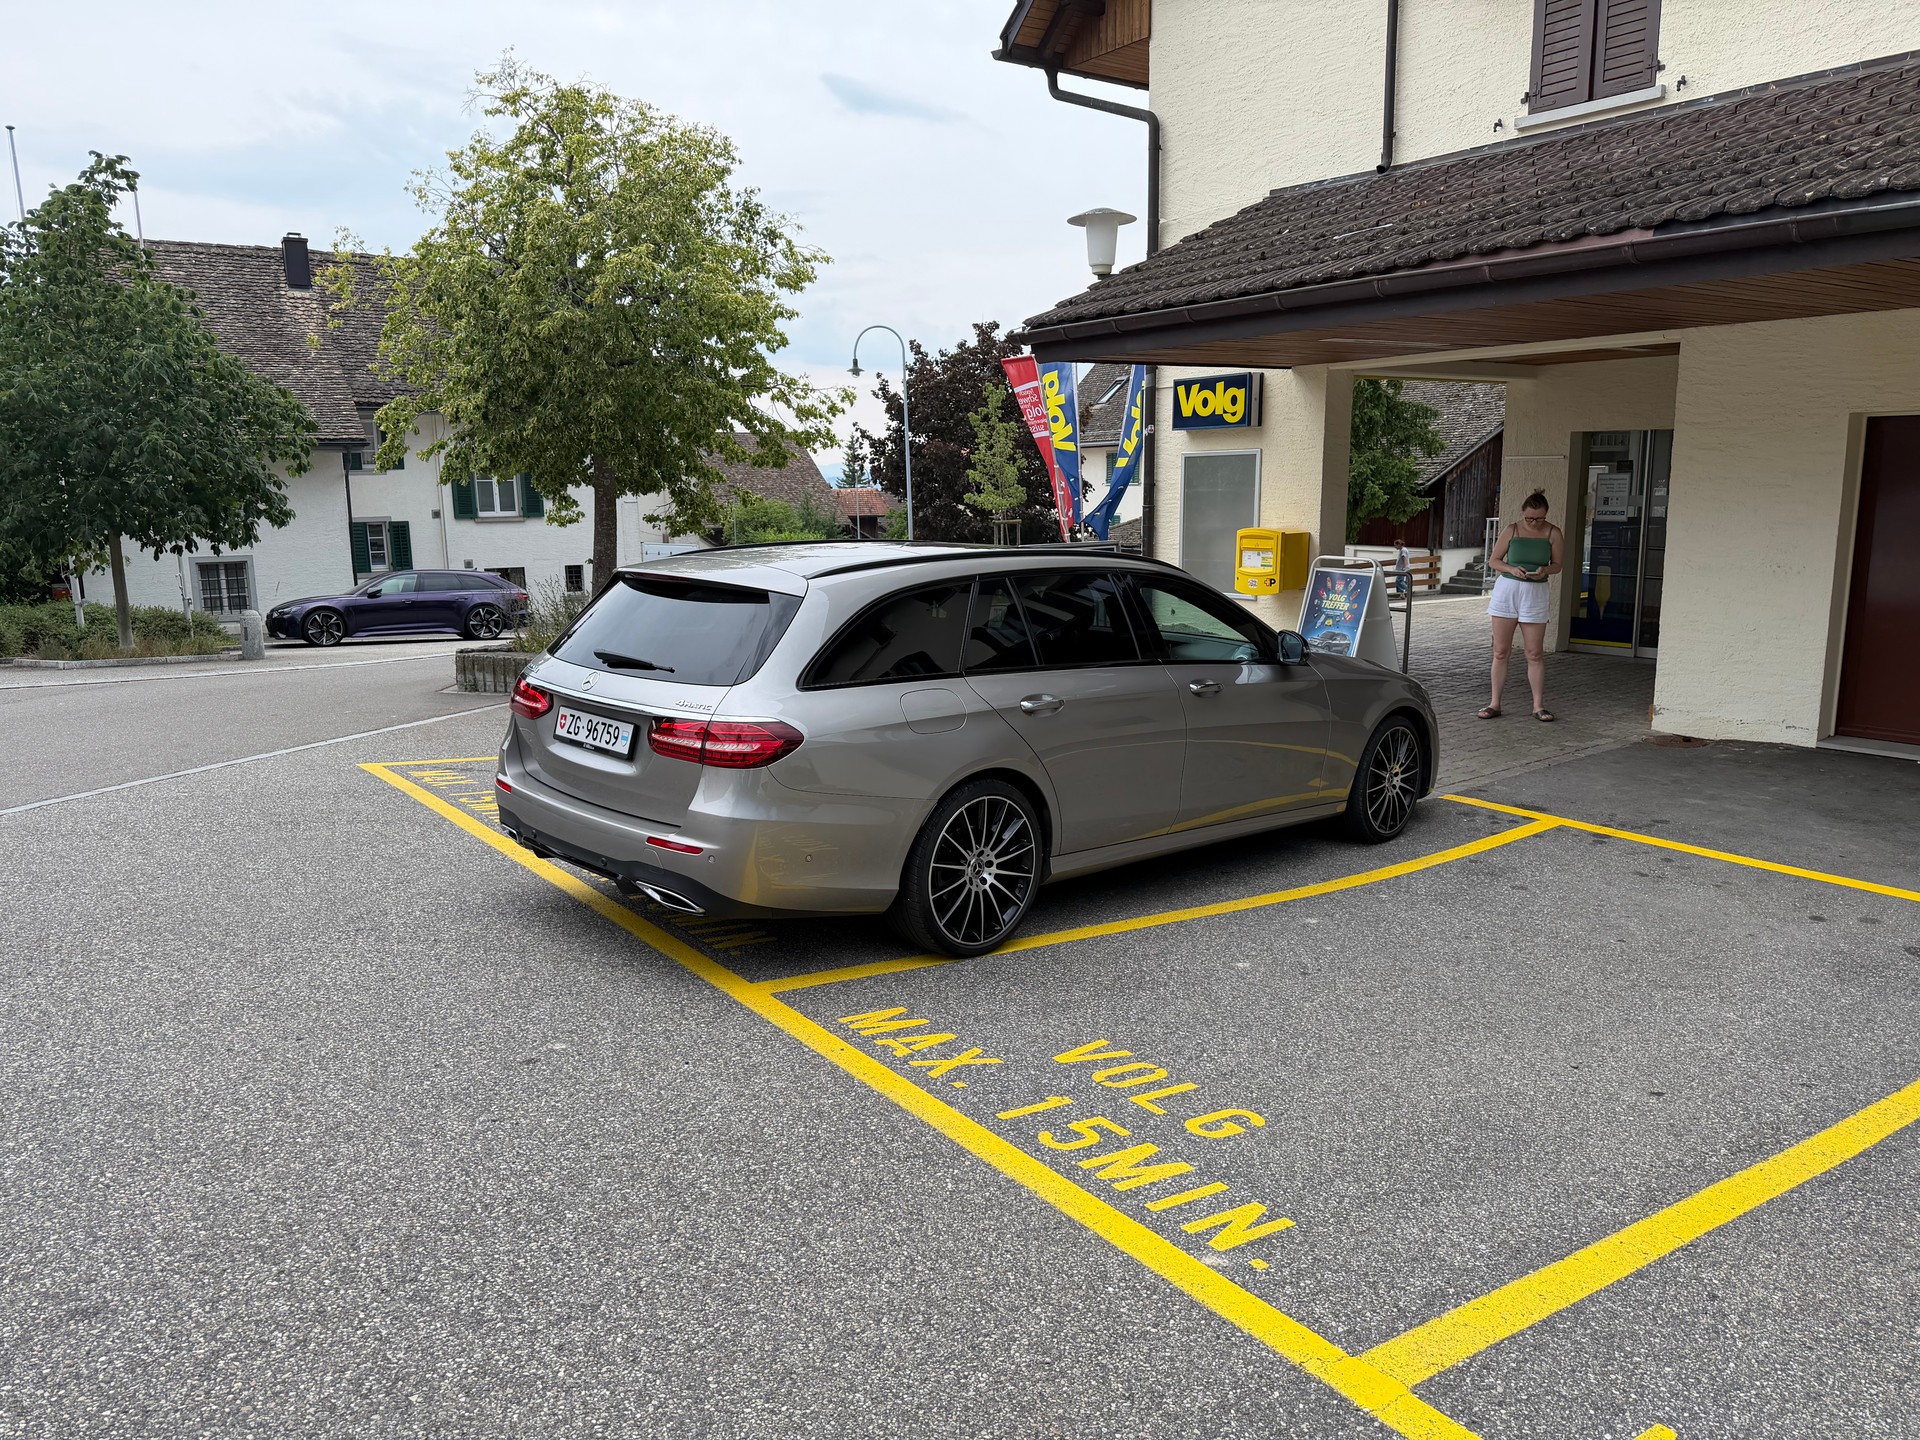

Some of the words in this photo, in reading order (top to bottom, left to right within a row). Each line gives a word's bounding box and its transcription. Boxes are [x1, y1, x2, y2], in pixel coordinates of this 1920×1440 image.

[1177, 381, 1246, 424] Volg
[1321, 600, 1350, 610] TREFFER
[1328, 593, 1347, 601] VOLG
[674, 699, 713, 711] 4MATIC
[838, 1007, 1004, 1088] MAX.
[1053, 1039, 1266, 1138] VOLG
